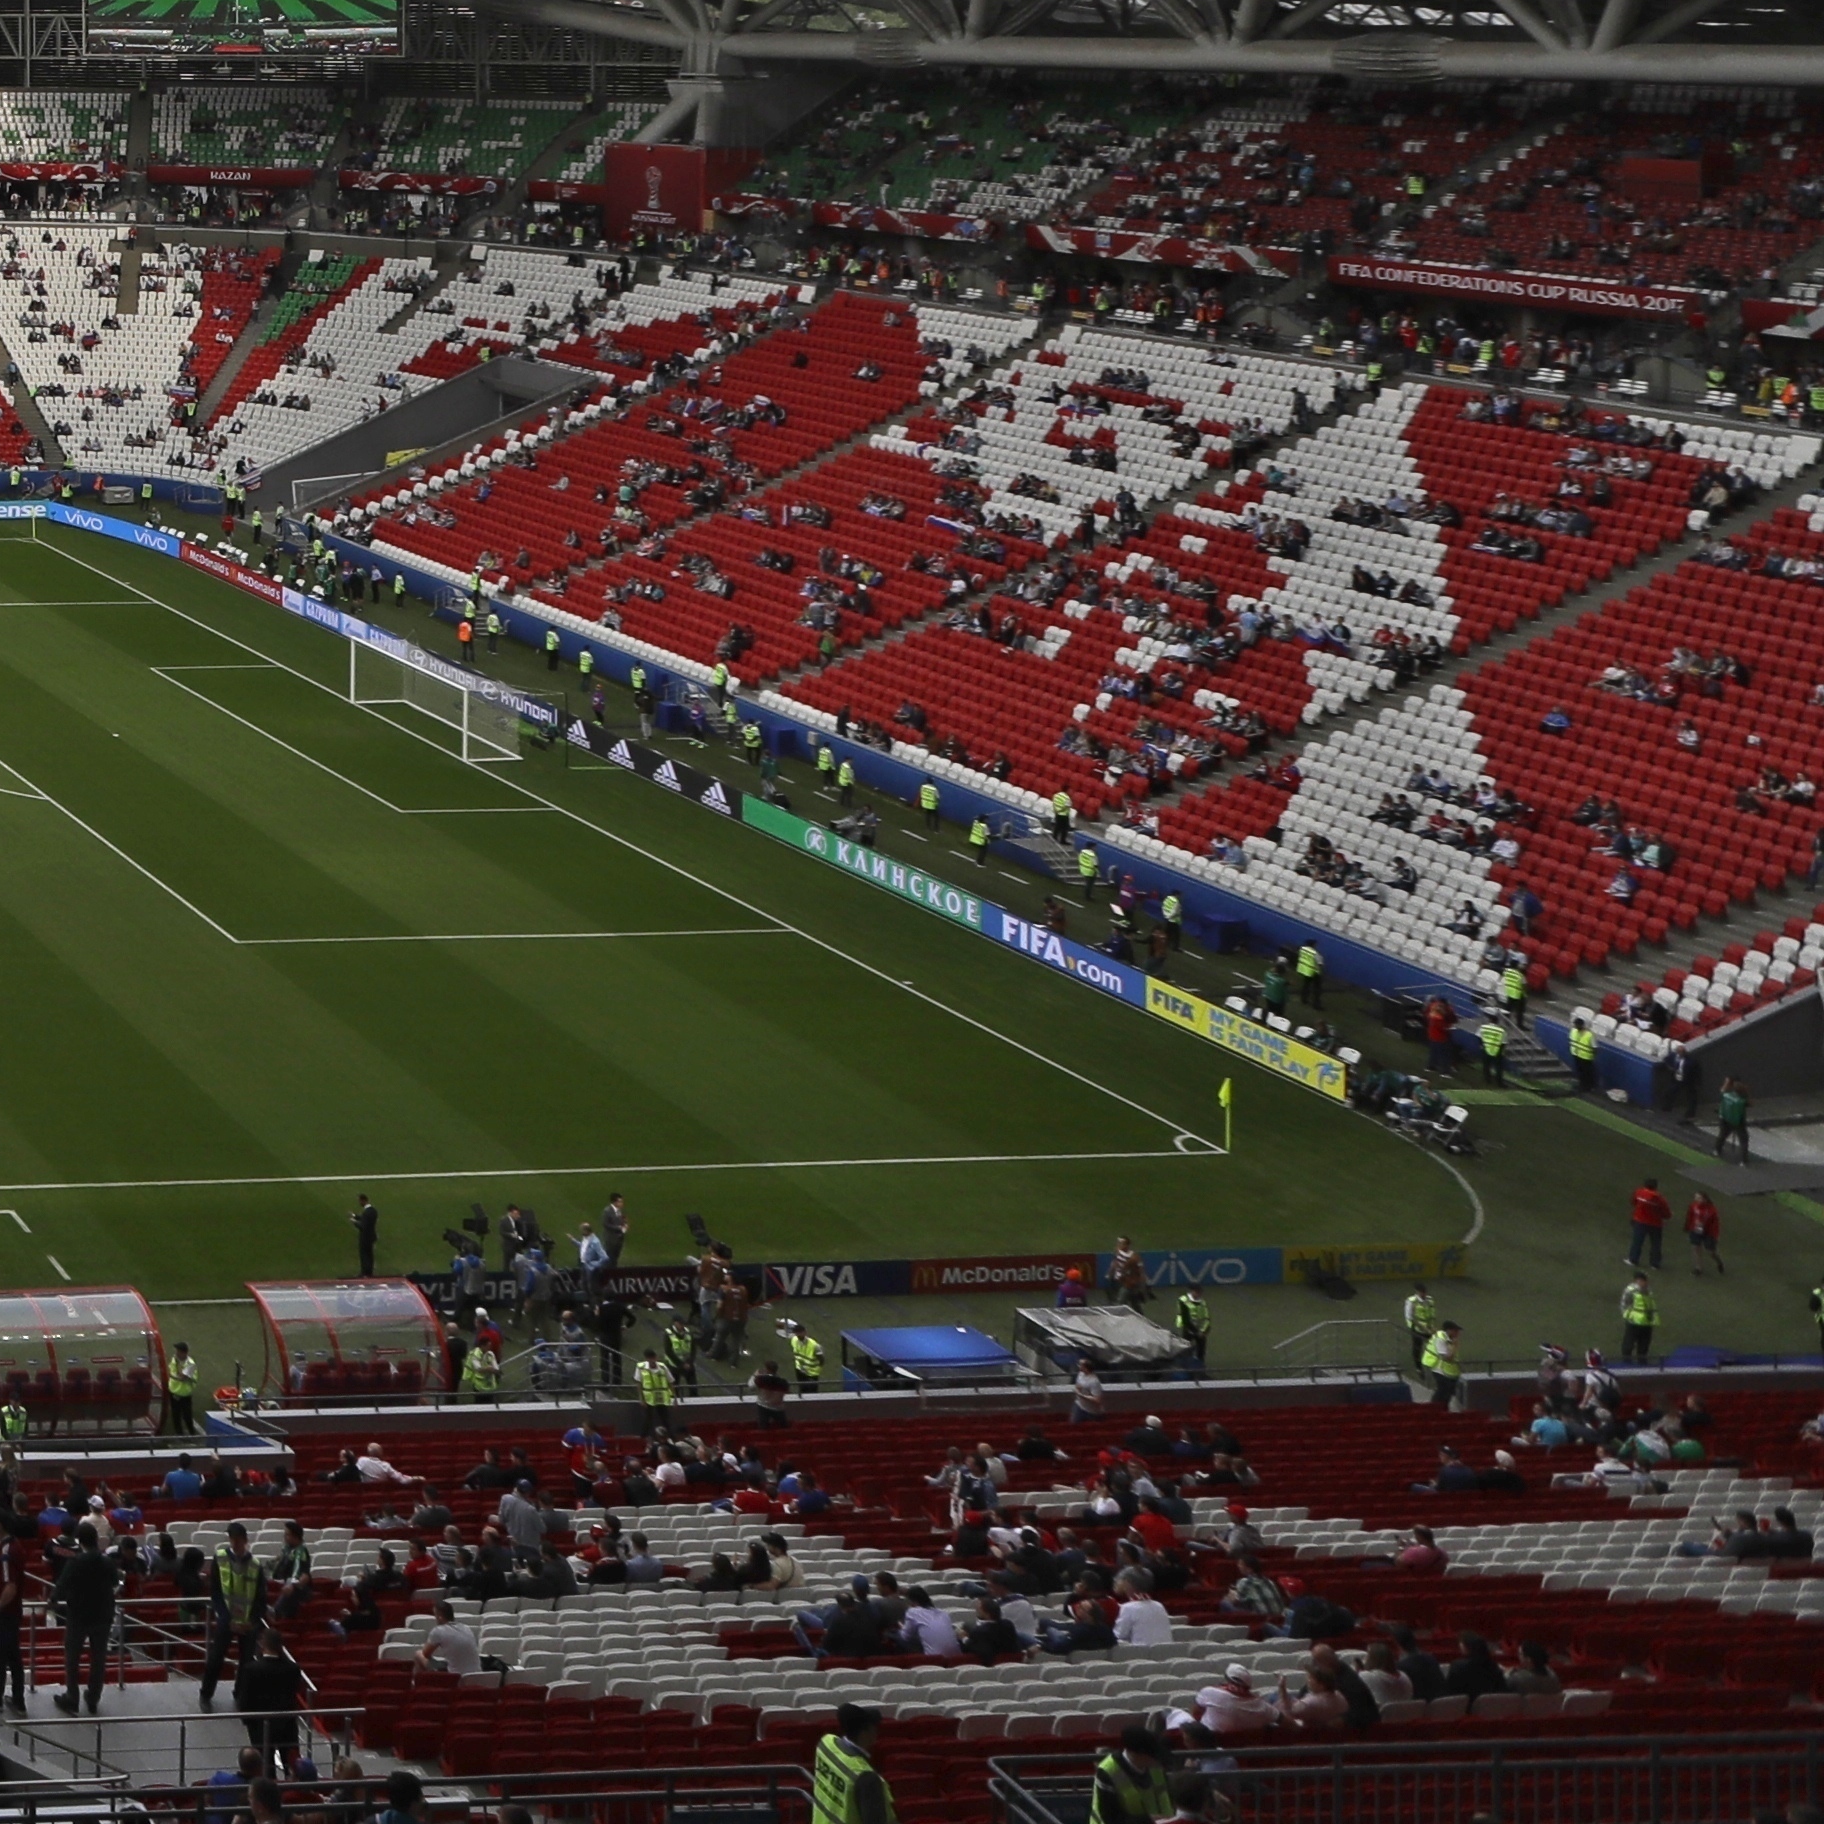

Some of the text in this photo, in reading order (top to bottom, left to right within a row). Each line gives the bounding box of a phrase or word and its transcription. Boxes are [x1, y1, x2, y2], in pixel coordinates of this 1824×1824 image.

[210, 171, 251, 180] KAZAN
[1338, 262, 1372, 279] FIFA
[1375, 266, 1524, 296] CONFEDERATIONS
[1527, 282, 1566, 299] CUP
[1568, 287, 1640, 309] RUSSIA
[190, 550, 280, 600] McDonald's McDonald's
[306, 600, 339, 629] GAZPROM
[430, 658, 553, 724] HYUNDAI HYUNDAI
[567, 732, 731, 815] adidas adidas adidas adidas
[836, 840, 978, 924] КЛИНСКОЕ
[1002, 913, 1122, 994] FIFA.com
[1152, 987, 1194, 1021] FIFA
[1210, 1008, 1289, 1054] MY GAME
[1211, 1024, 1310, 1079] IS FAIR PLAY
[607, 1276, 689, 1294] AIRWAYS
[772, 1265, 858, 1295] VISA
[942, 1264, 1065, 1287] McDonald's
